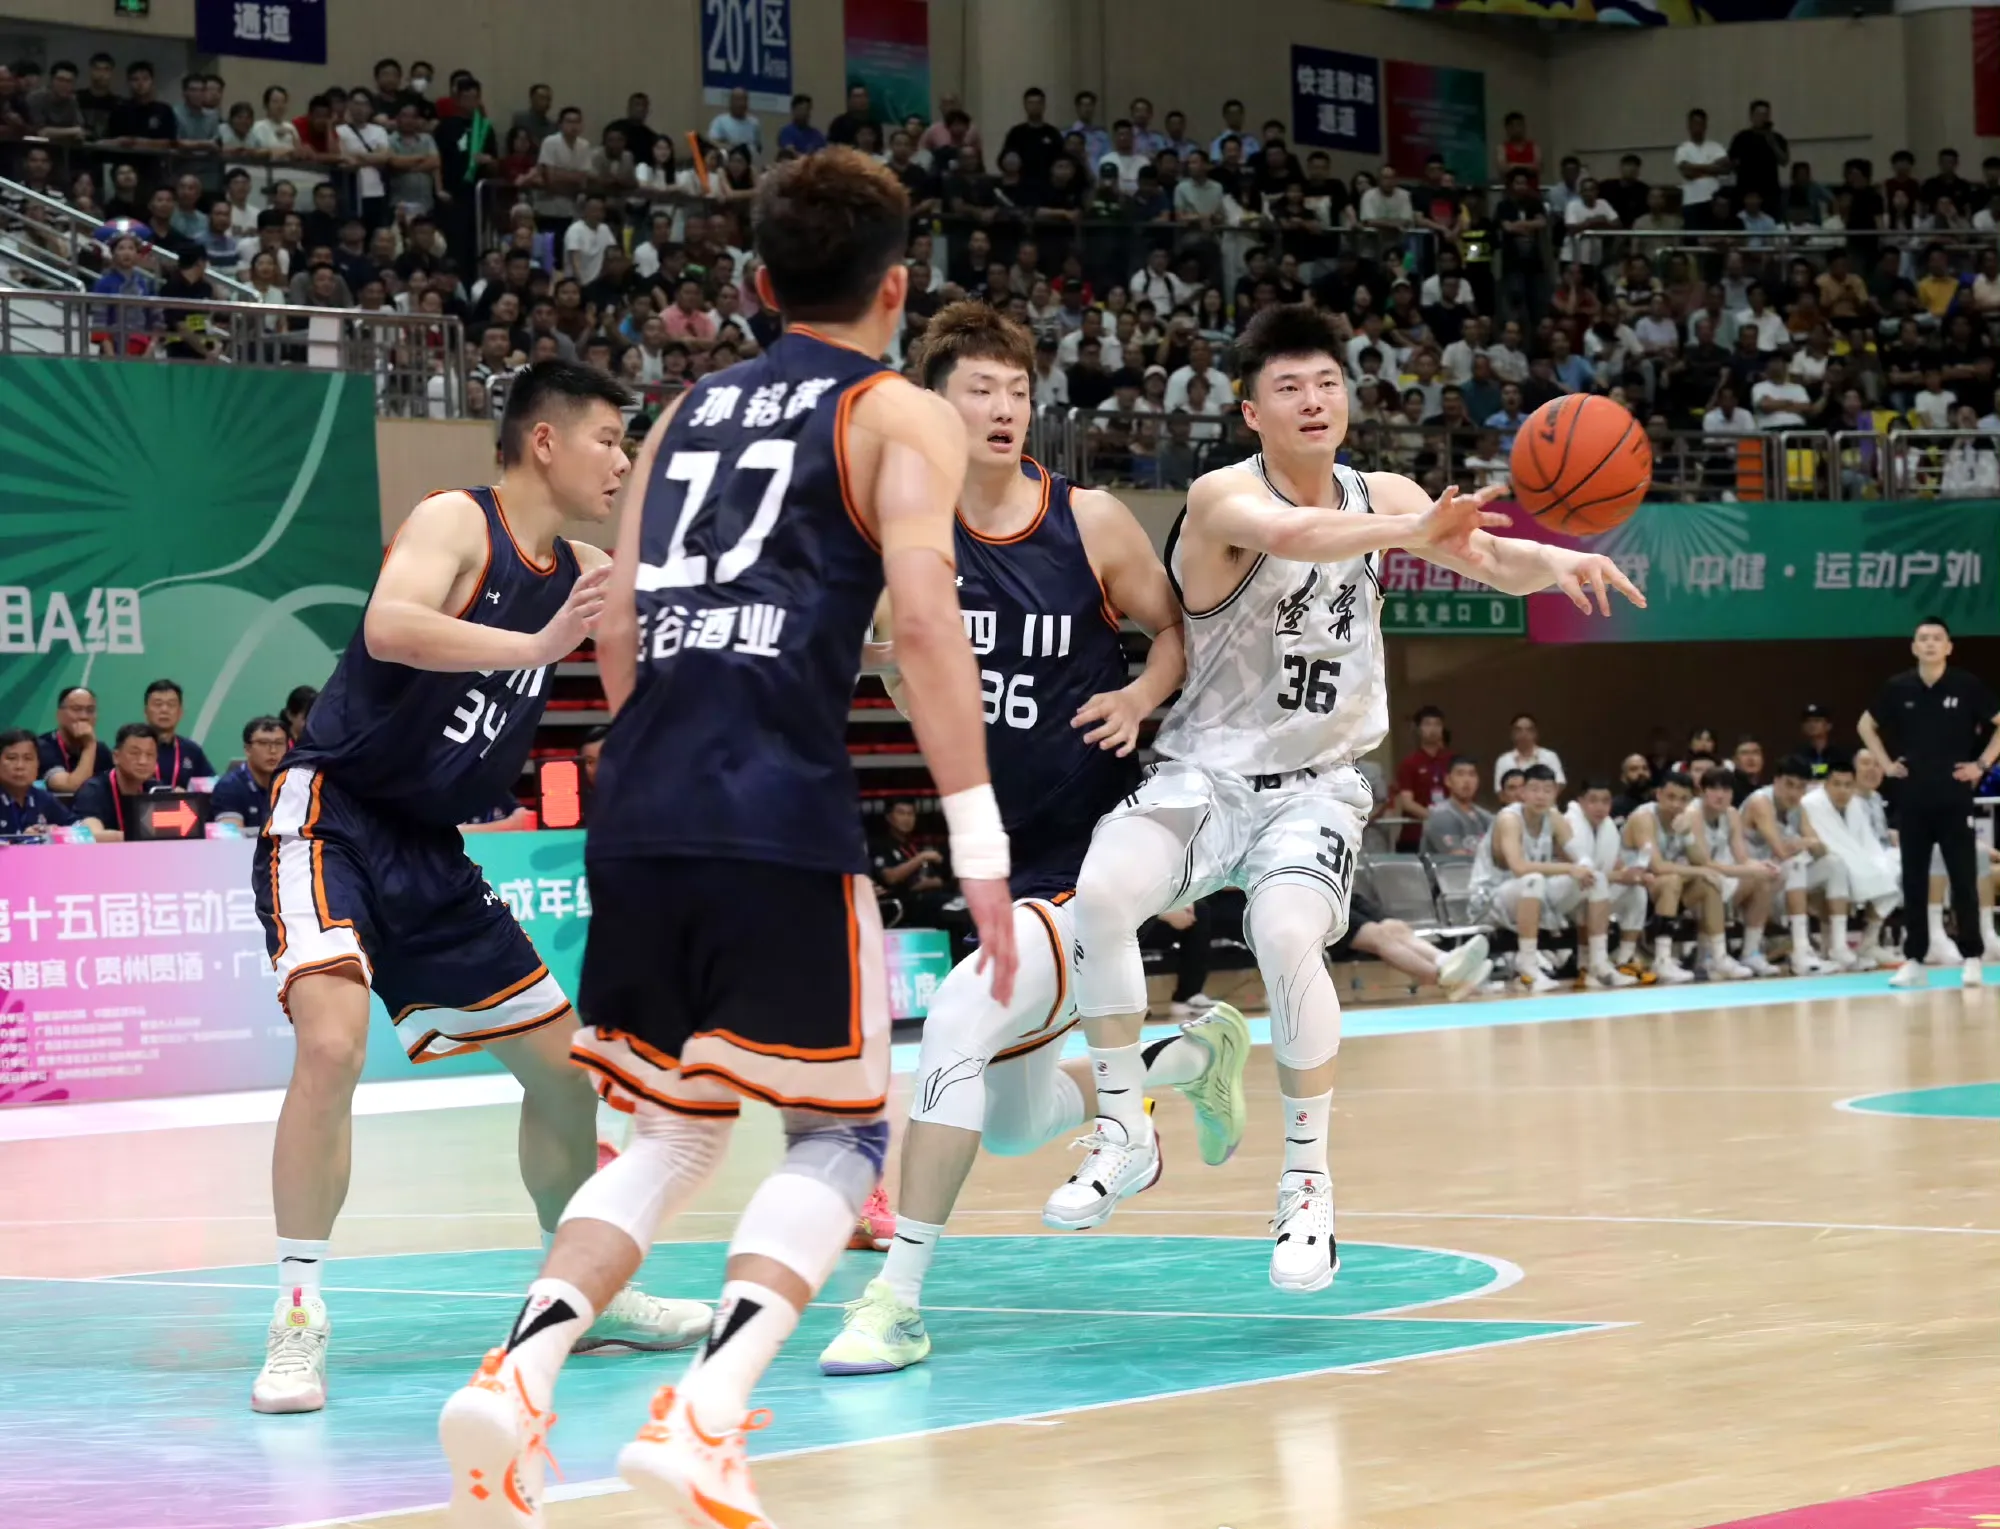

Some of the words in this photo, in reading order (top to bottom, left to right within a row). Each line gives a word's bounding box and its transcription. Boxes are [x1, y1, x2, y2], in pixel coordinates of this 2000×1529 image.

[233, 2, 290, 42] 通道
[635, 439, 797, 592] 17
[637, 603, 786, 662] 谷酒业
[960, 609, 1072, 658] 四川
[1490, 601, 1506, 626] D
[981, 669, 1038, 729] 36
[1277, 654, 1341, 714] 36
[442, 688, 508, 759] 34
